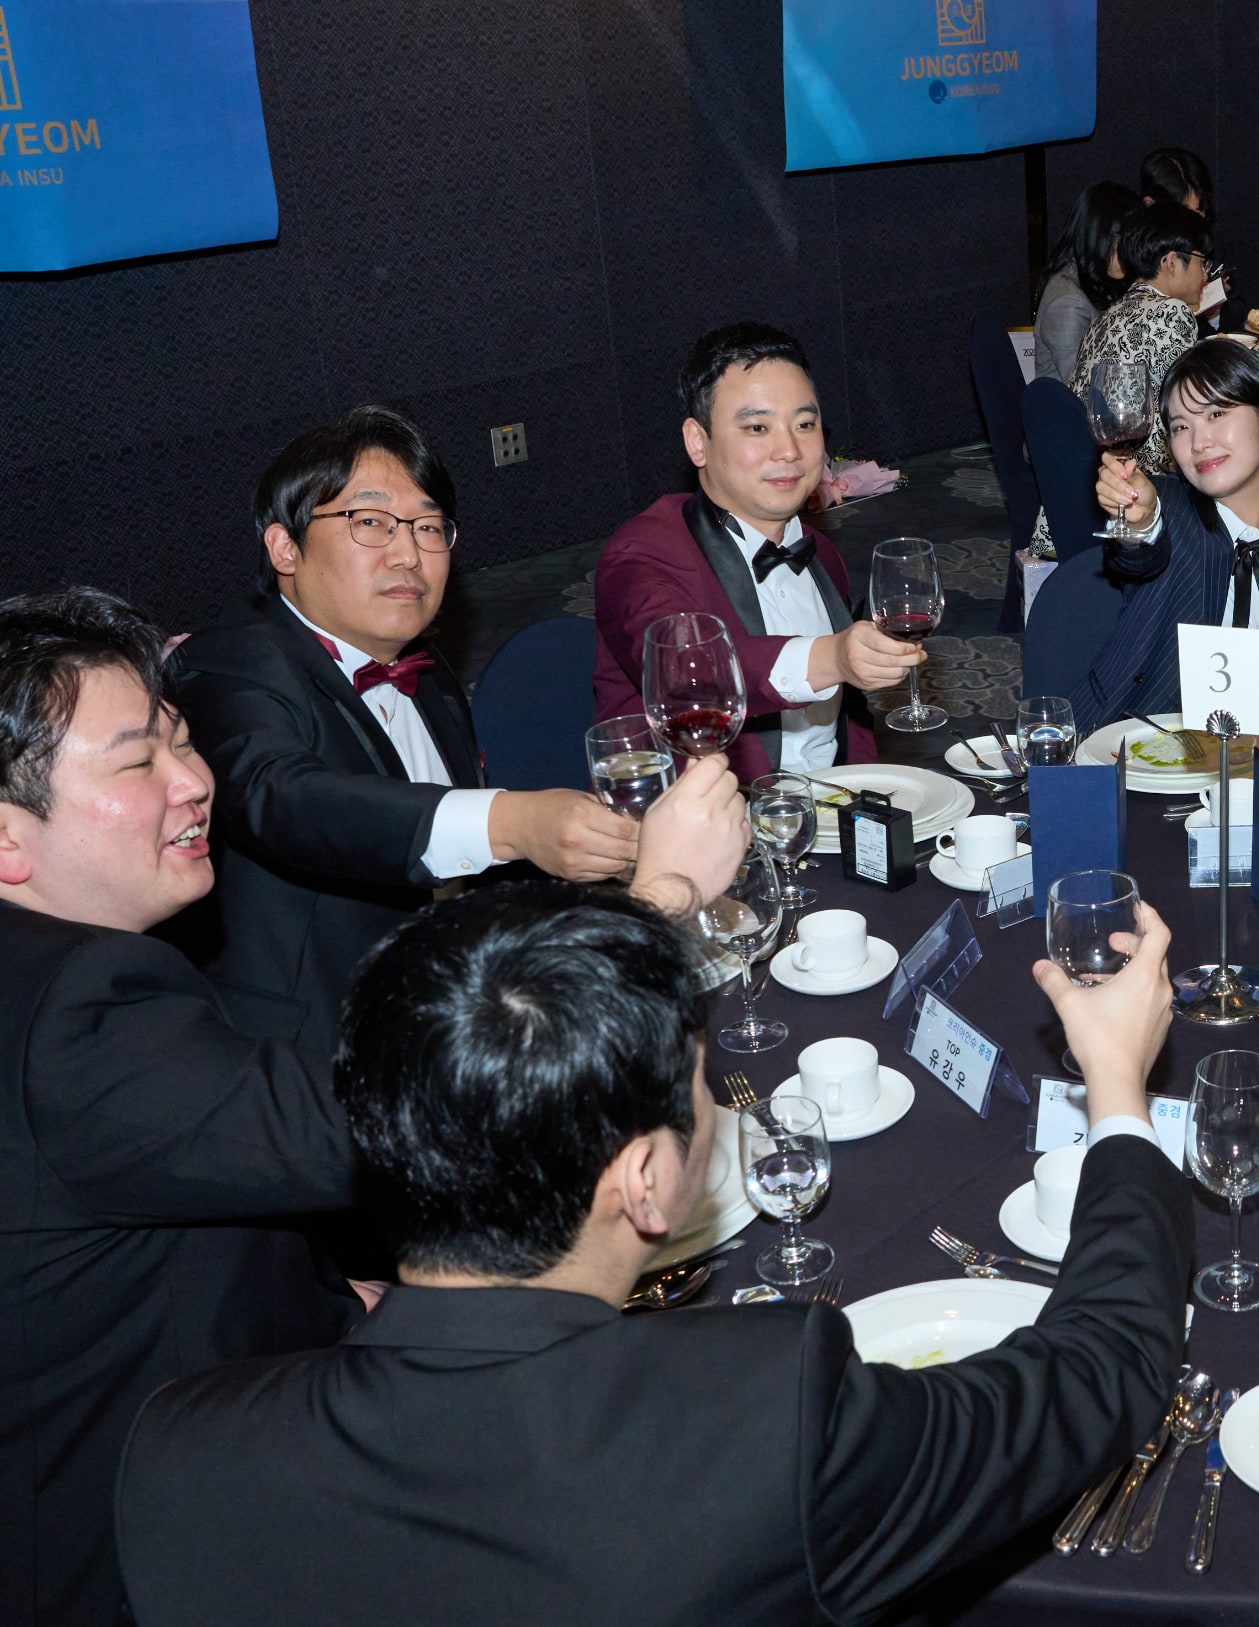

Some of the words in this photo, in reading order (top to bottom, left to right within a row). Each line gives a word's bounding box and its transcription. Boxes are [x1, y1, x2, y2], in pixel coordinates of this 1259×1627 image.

[900, 50, 1018, 80] JUNGGYEOM
[17, 168, 64, 187] INSU
[1208, 651, 1233, 693] 3
[945, 1017, 977, 1049] 코리아인슈
[945, 1039, 961, 1057] TOP
[1157, 1103, 1181, 1119] 중겸
